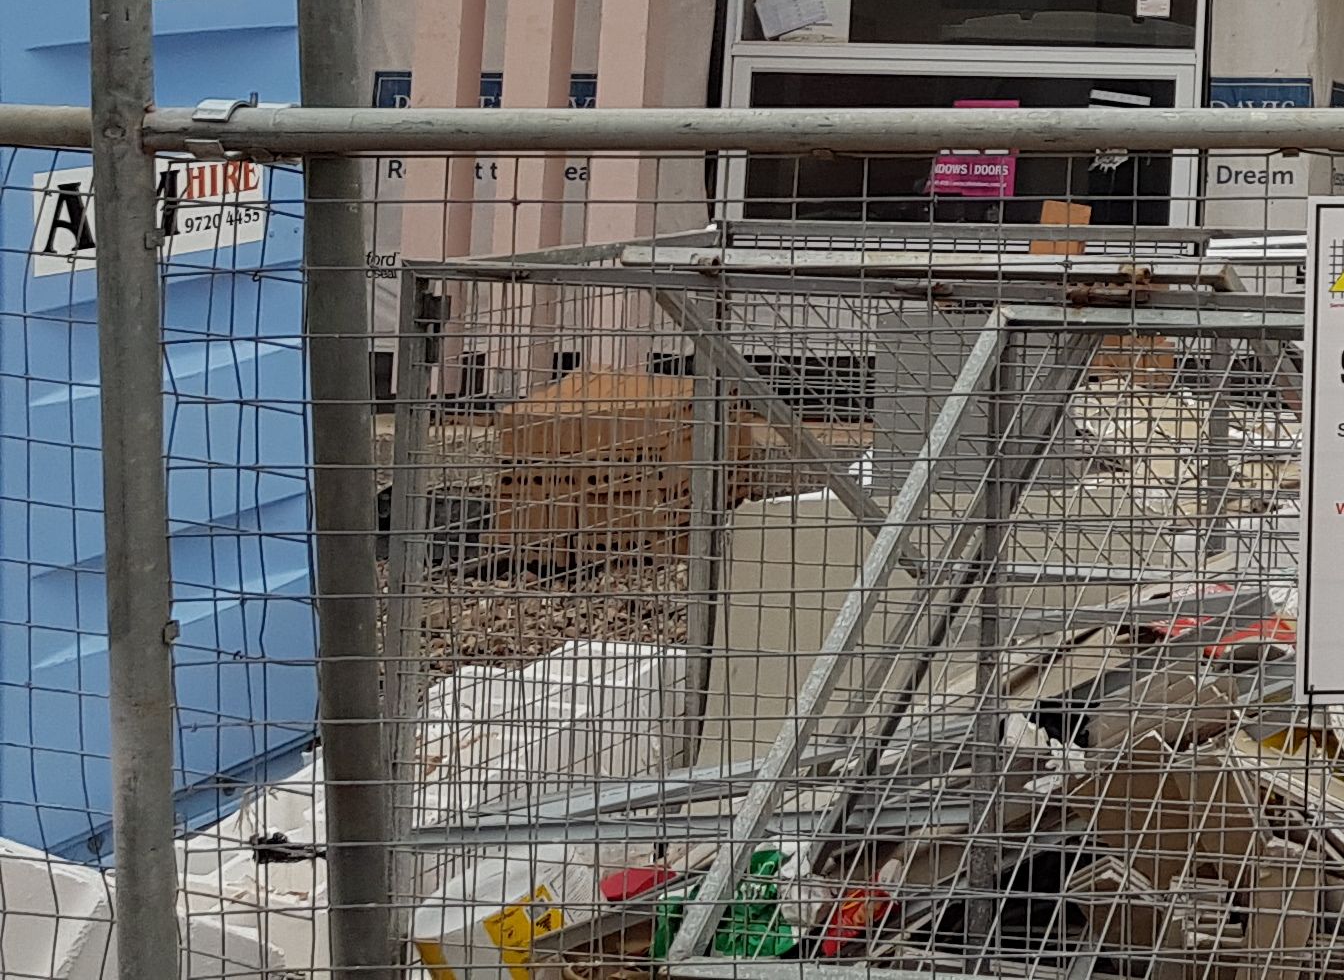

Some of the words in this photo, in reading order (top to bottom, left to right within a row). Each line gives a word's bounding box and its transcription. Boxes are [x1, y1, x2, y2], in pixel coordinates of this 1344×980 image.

[184, 161, 260, 200] HIRE
[1216, 165, 1294, 185] Dream
[185, 213, 221, 234] 9720
[226, 209, 261, 226] 4455
